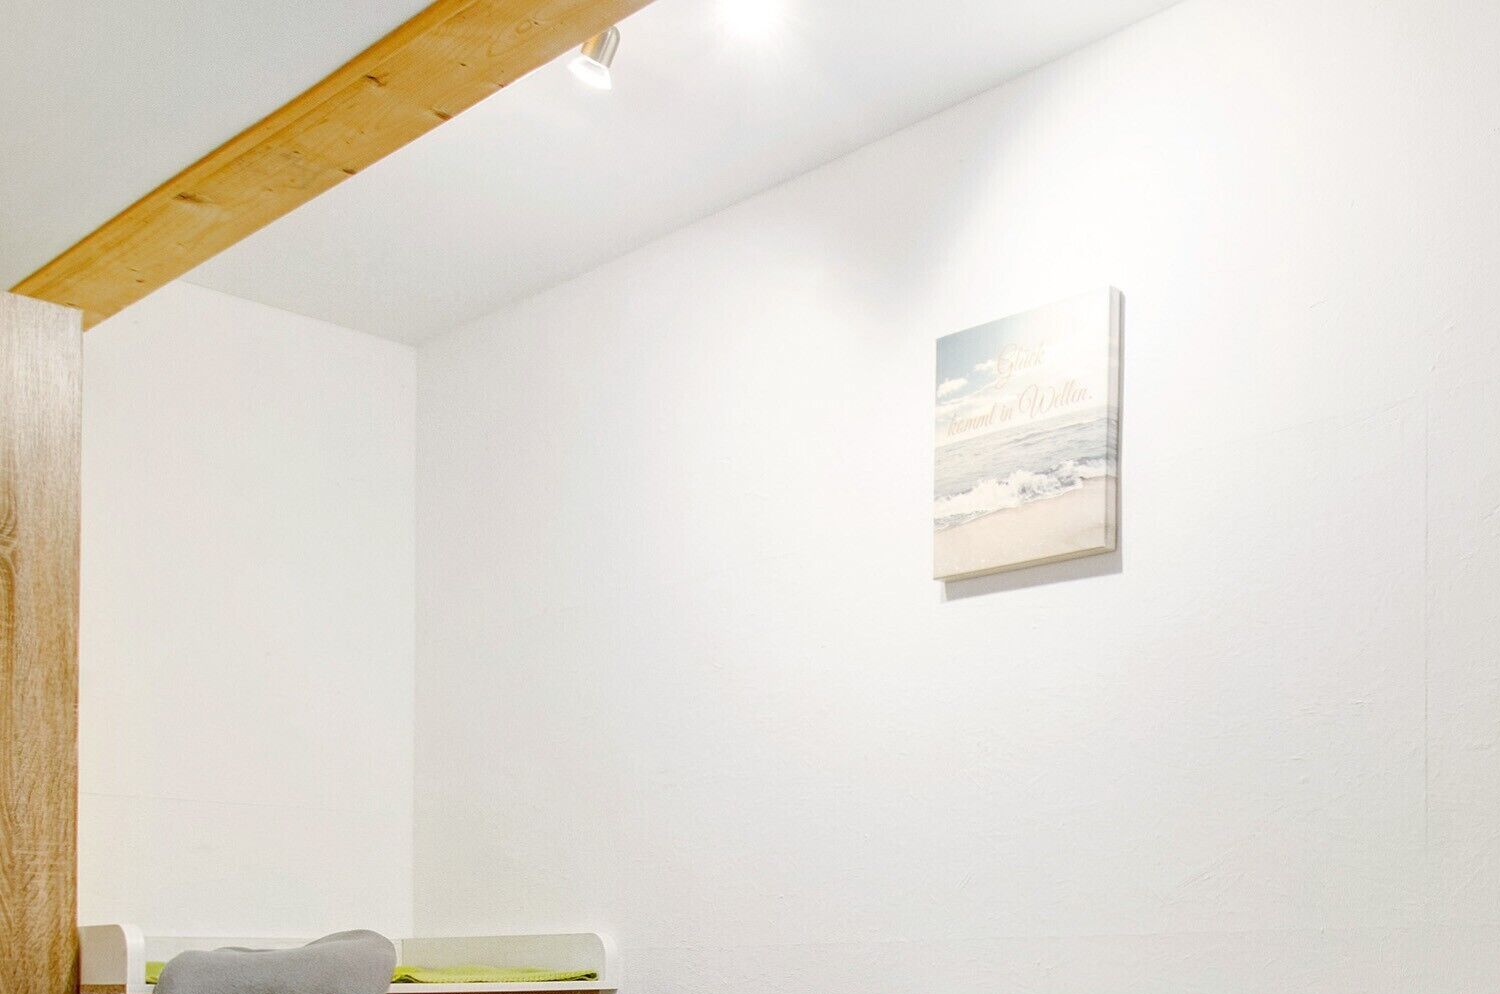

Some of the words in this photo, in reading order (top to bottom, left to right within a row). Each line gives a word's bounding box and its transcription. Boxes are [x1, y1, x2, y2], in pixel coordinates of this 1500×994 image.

[996, 342, 1045, 389] Glück
[946, 403, 995, 437] kommt
[999, 403, 1013, 421] in
